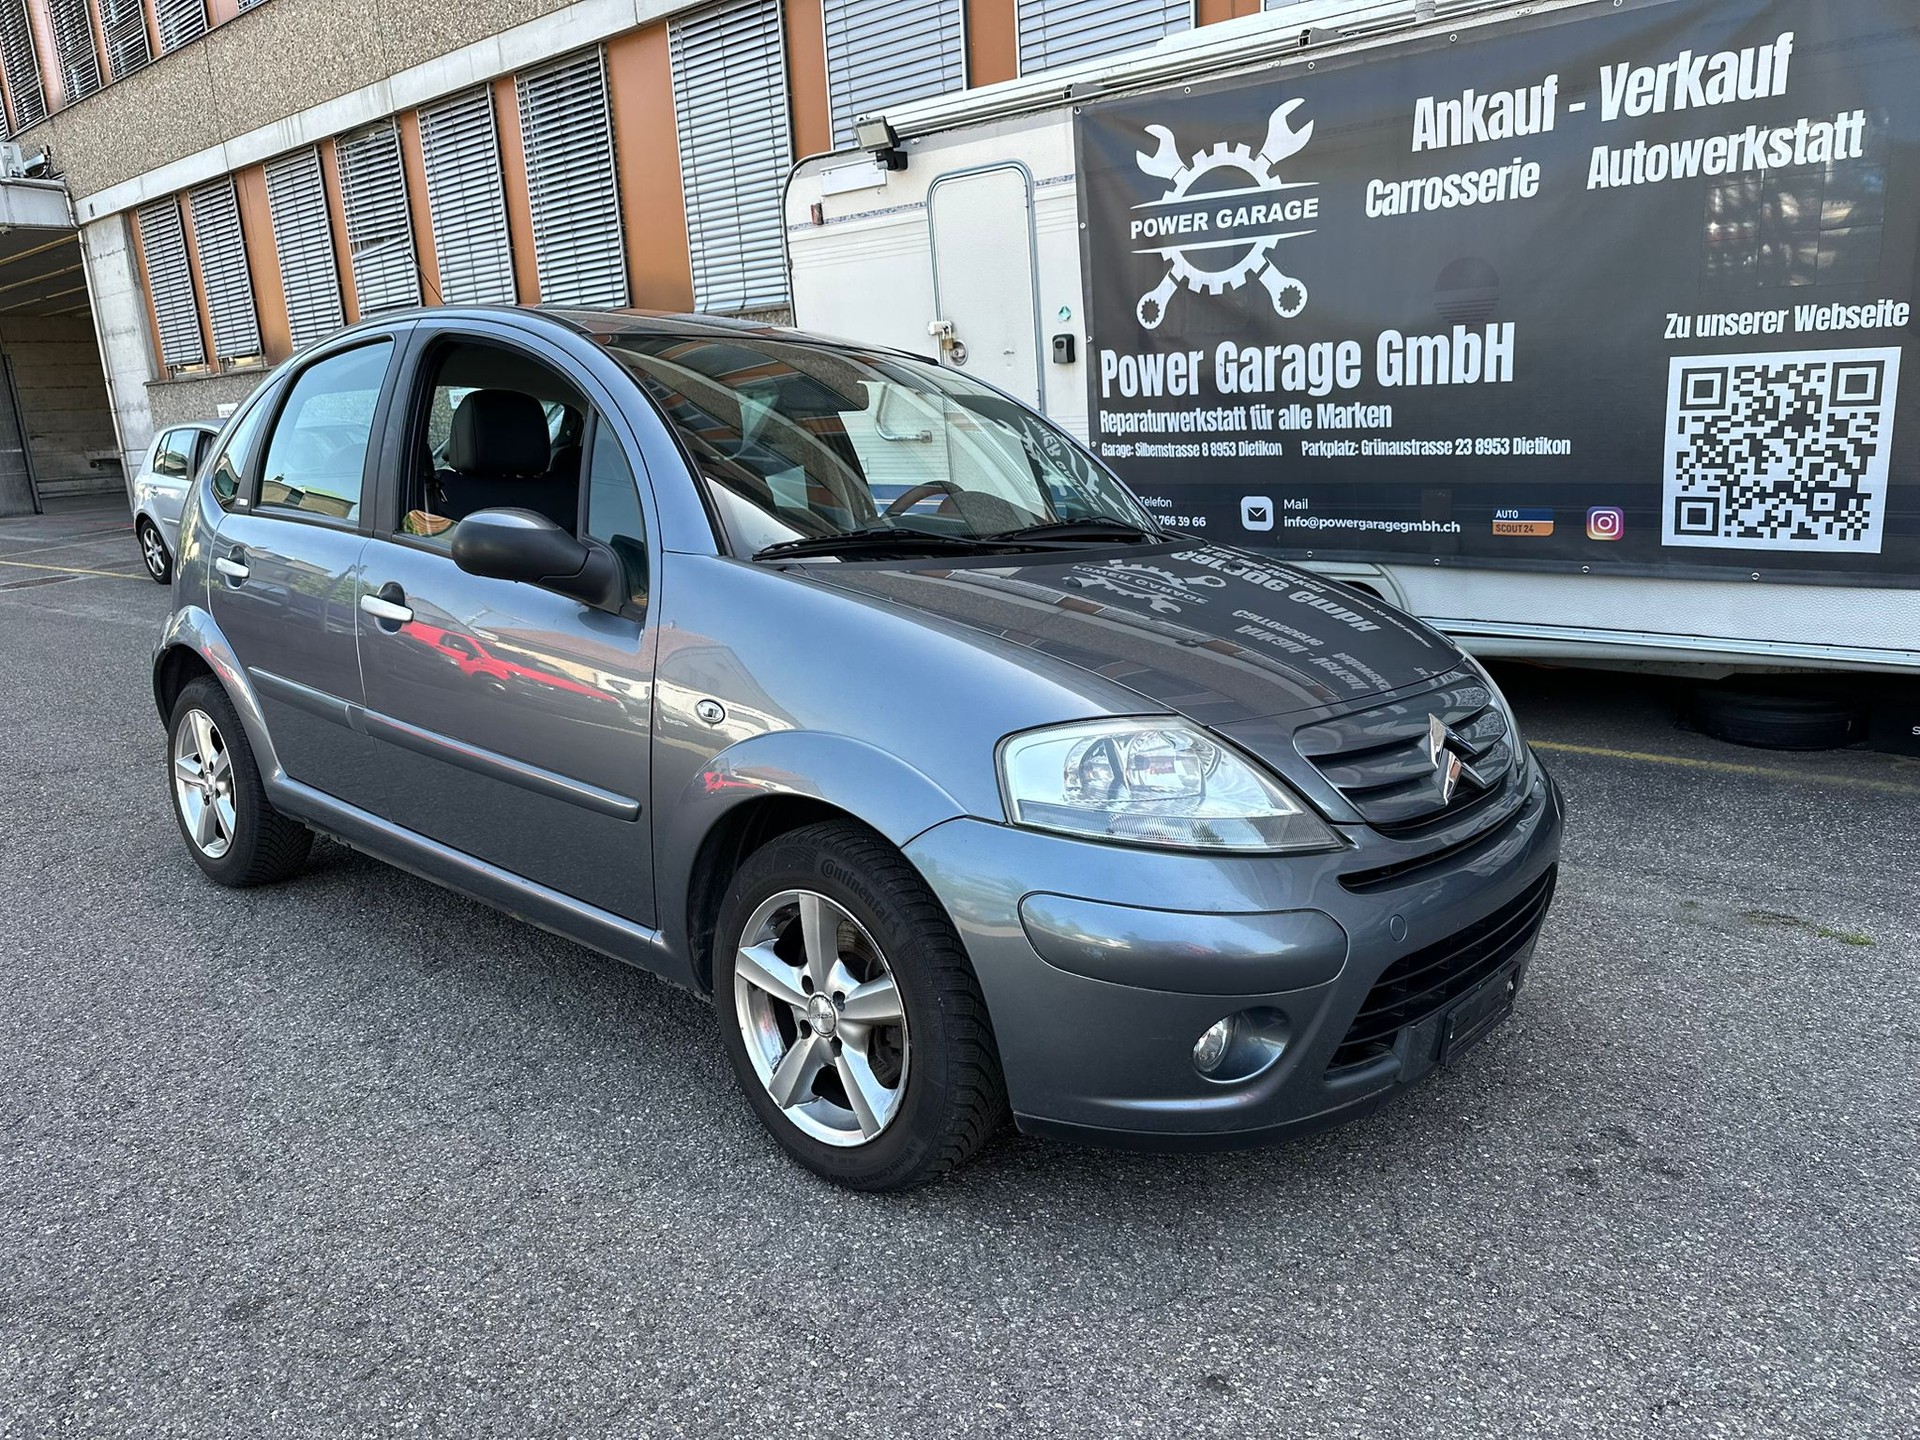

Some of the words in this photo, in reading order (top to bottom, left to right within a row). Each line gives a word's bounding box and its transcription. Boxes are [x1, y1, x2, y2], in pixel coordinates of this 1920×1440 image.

[1411, 73, 1559, 153] Ankauf
[1599, 31, 1797, 123] Verkauf
[1365, 156, 1541, 218] Carrosserie
[1586, 110, 1866, 192] Autowerkstatt
[1130, 213, 1209, 240] POWER
[1215, 197, 1319, 230] GARAGE
[1663, 312, 1692, 340] Zu
[1695, 307, 1788, 338] unserer
[1794, 298, 1911, 333] Webseite
[1100, 349, 1203, 399] Power
[1215, 340, 1362, 397] Garage
[1376, 321, 1516, 388] GmbH
[1099, 406, 1248, 437] Reparaturwerkstatt
[1250, 403, 1275, 431] für
[1278, 403, 1313, 431] alle
[1316, 401, 1393, 430] Marken
[1101, 442, 1134, 459] Garage:
[1201, 441, 1209, 457] 8
[1210, 441, 1237, 458] 8953
[1238, 440, 1283, 457] Dietikon
[1301, 438, 1359, 459] Parkplatz:
[1361, 438, 1453, 457] Grünaustrasse
[1454, 438, 1473, 456] 23
[1474, 437, 1511, 456] 8953
[1512, 436, 1572, 456] Dietikon
[1139, 496, 1173, 508] Telefon
[1283, 498, 1309, 511] Mail
[1495, 509, 1519, 519] AUTO
[1177, 515, 1190, 527] 39
[1191, 516, 1207, 528] 66
[1283, 515, 1462, 534] info@powergaragegmbh.ch
[820, 858, 891, 925] Continental
